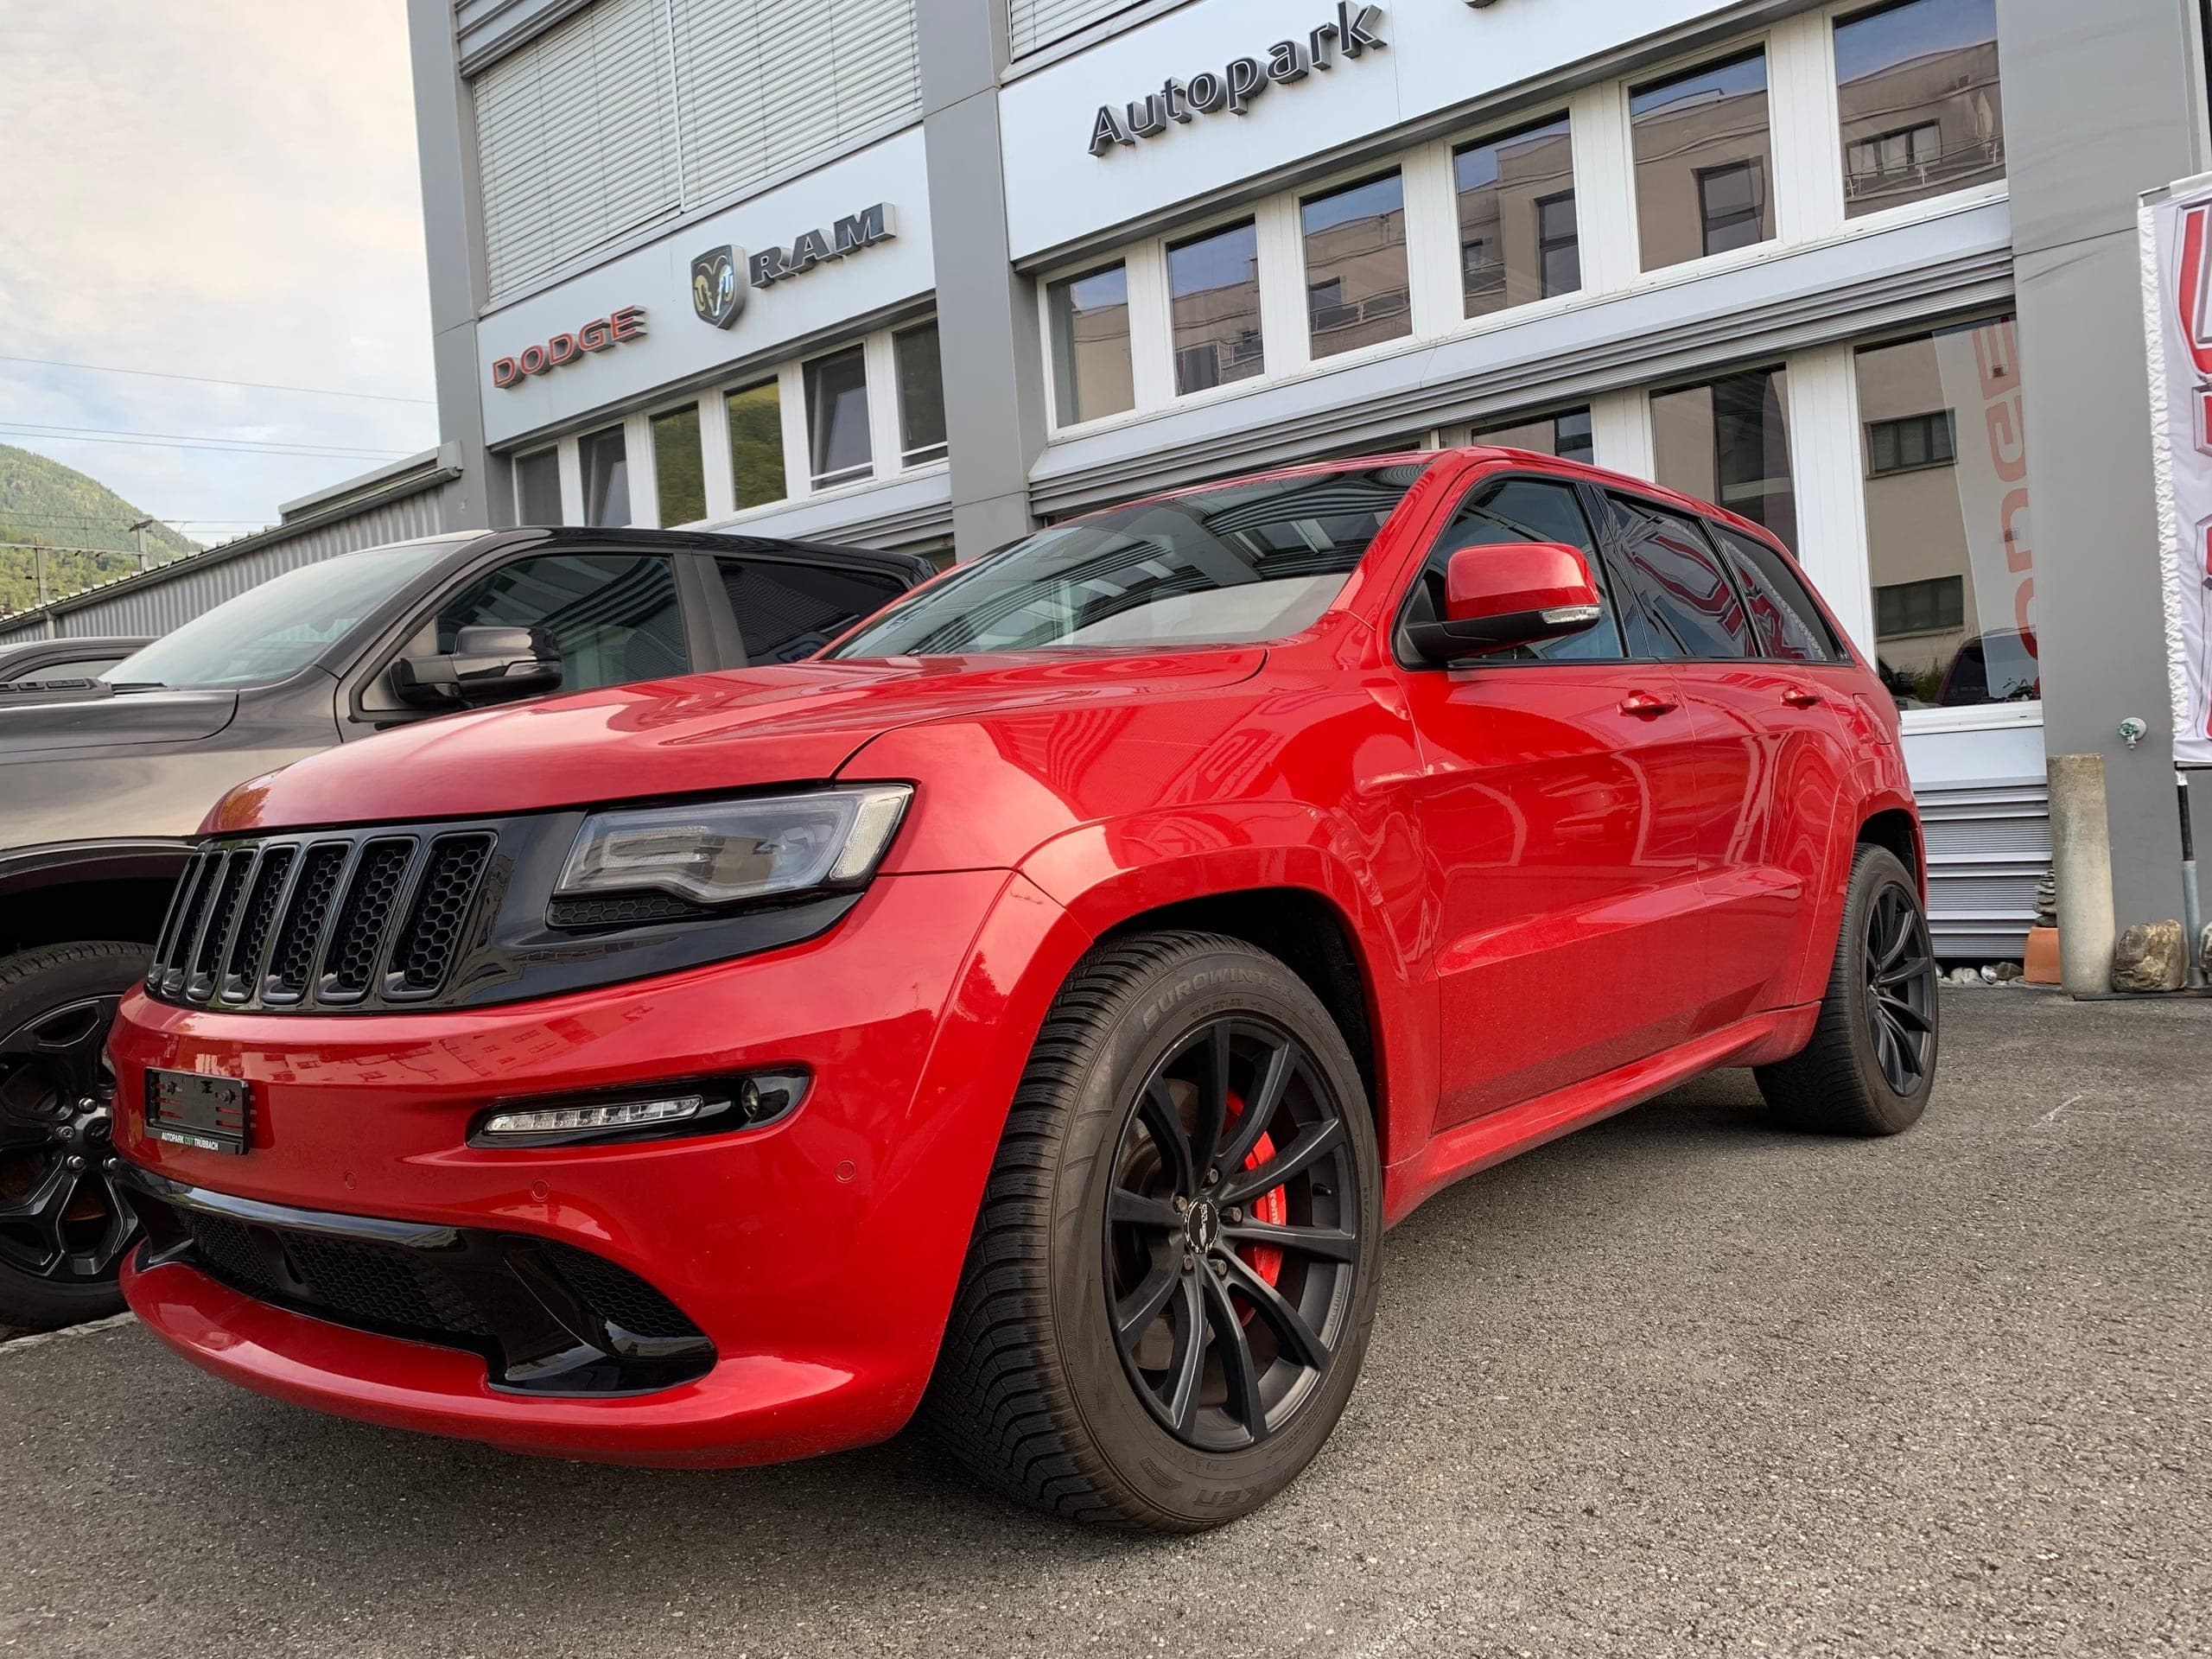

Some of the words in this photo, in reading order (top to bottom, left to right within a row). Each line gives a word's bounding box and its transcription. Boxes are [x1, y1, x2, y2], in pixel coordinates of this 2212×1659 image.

[1088, 0, 1387, 156] Autopark
[749, 202, 896, 289] RAM
[492, 305, 647, 389] DODGE
[161, 1132, 185, 1144] AUTOPARK
